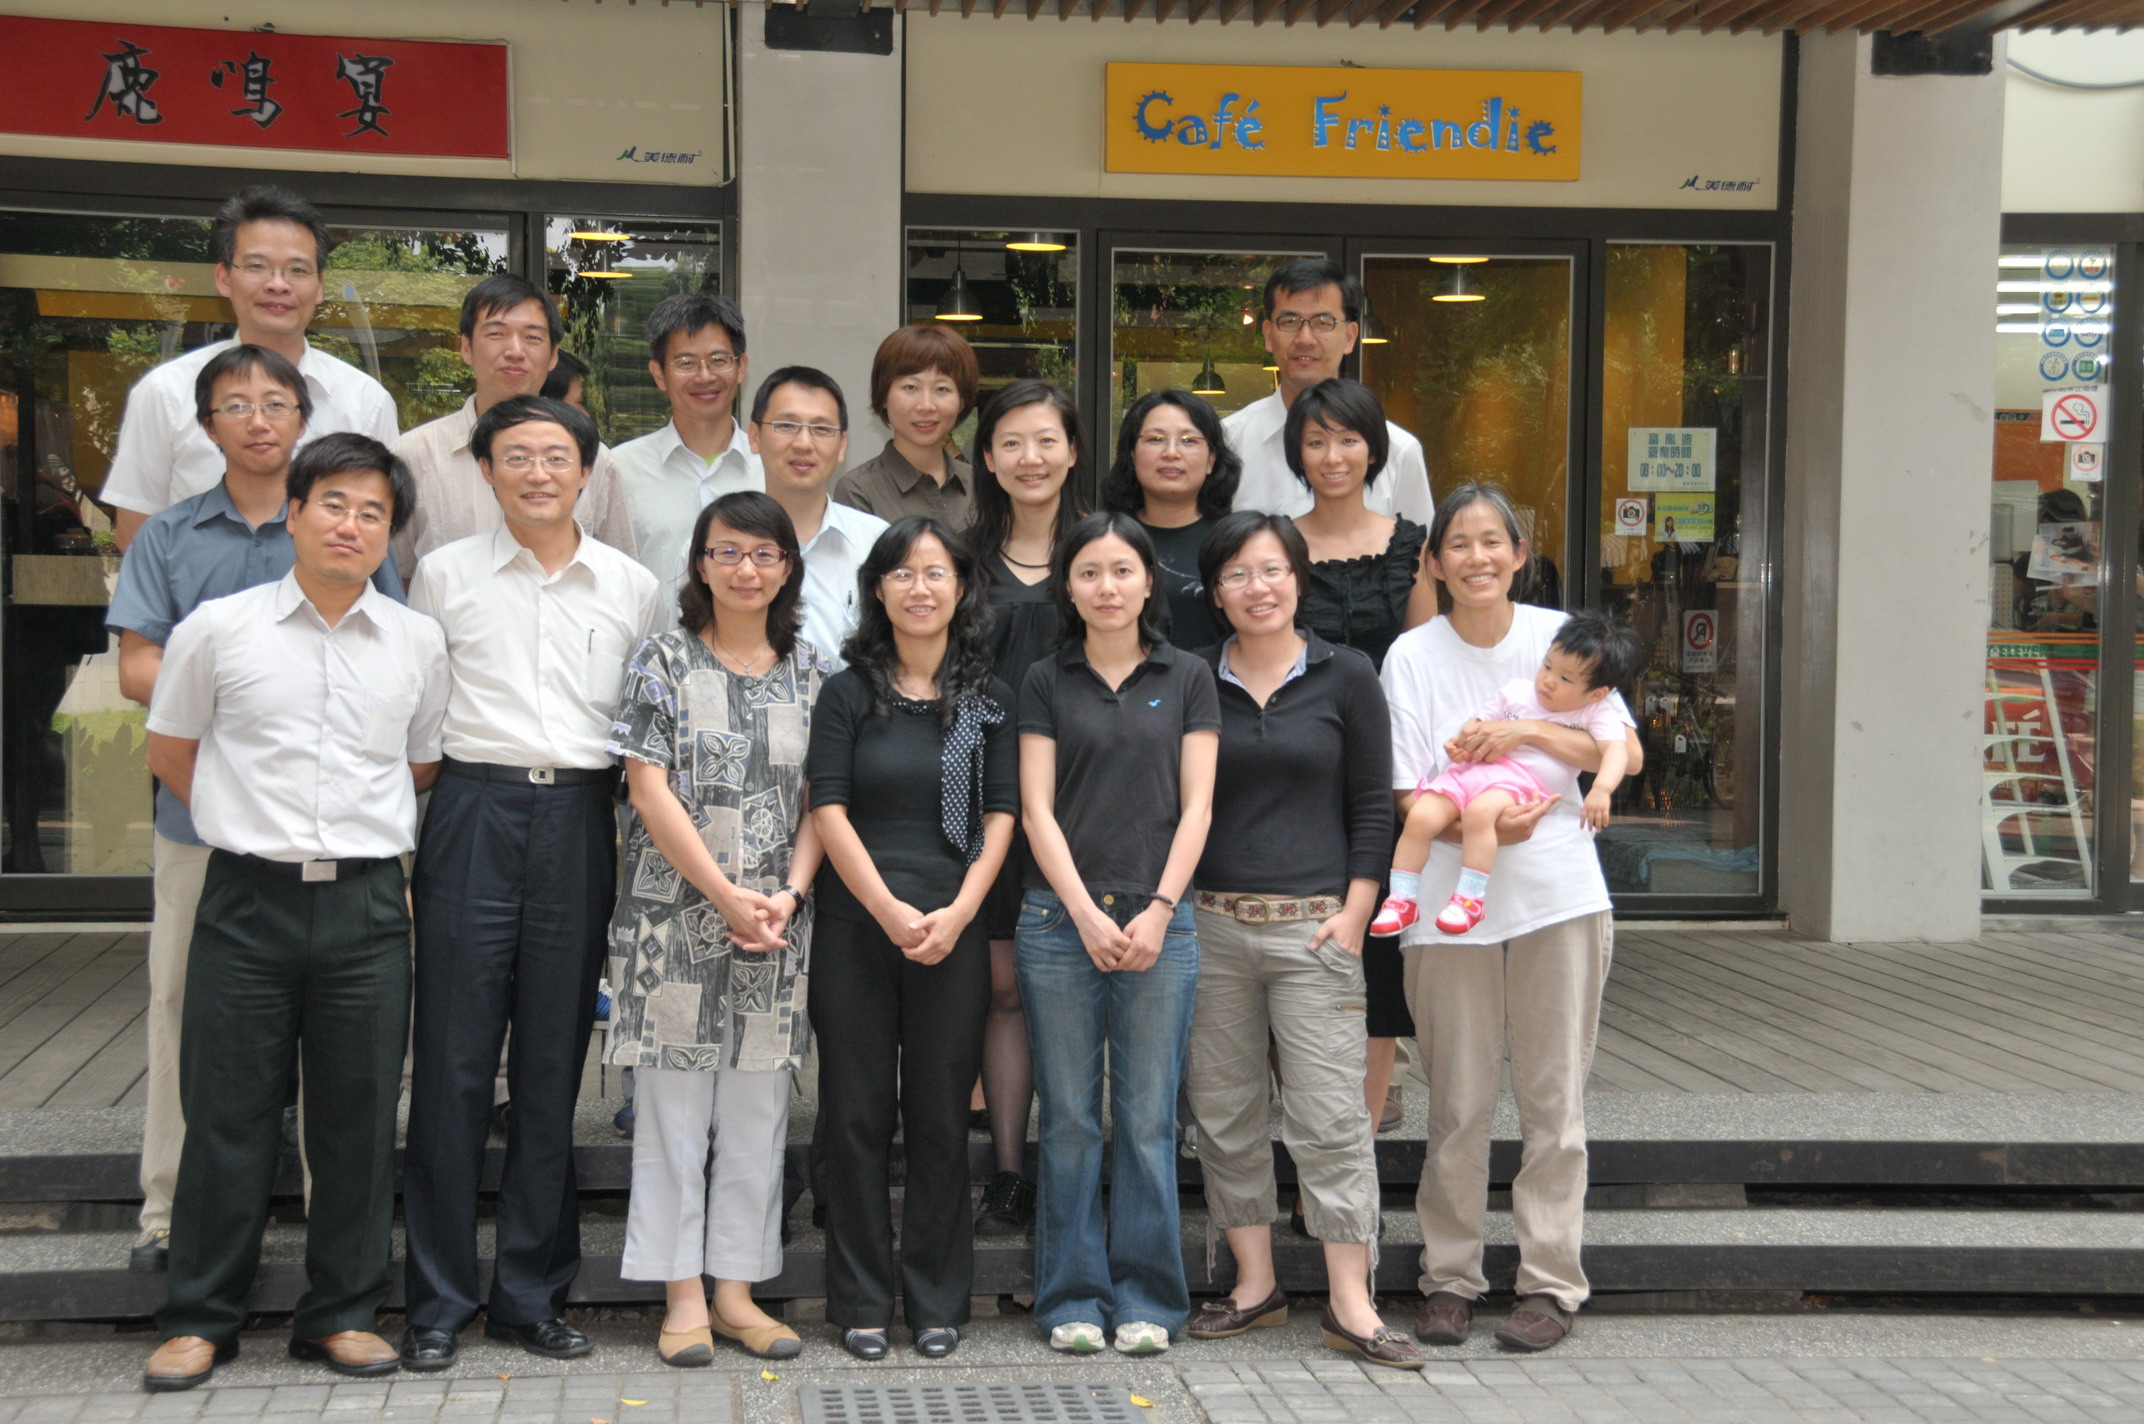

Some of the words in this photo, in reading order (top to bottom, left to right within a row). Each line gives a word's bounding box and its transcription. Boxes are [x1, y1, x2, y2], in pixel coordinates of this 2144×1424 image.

[84, 38, 395, 137] 鹿鳴宴
[1132, 89, 1265, 151] Café
[1313, 90, 1557, 156] Friendie
[1648, 446, 1692, 458] 營業時間
